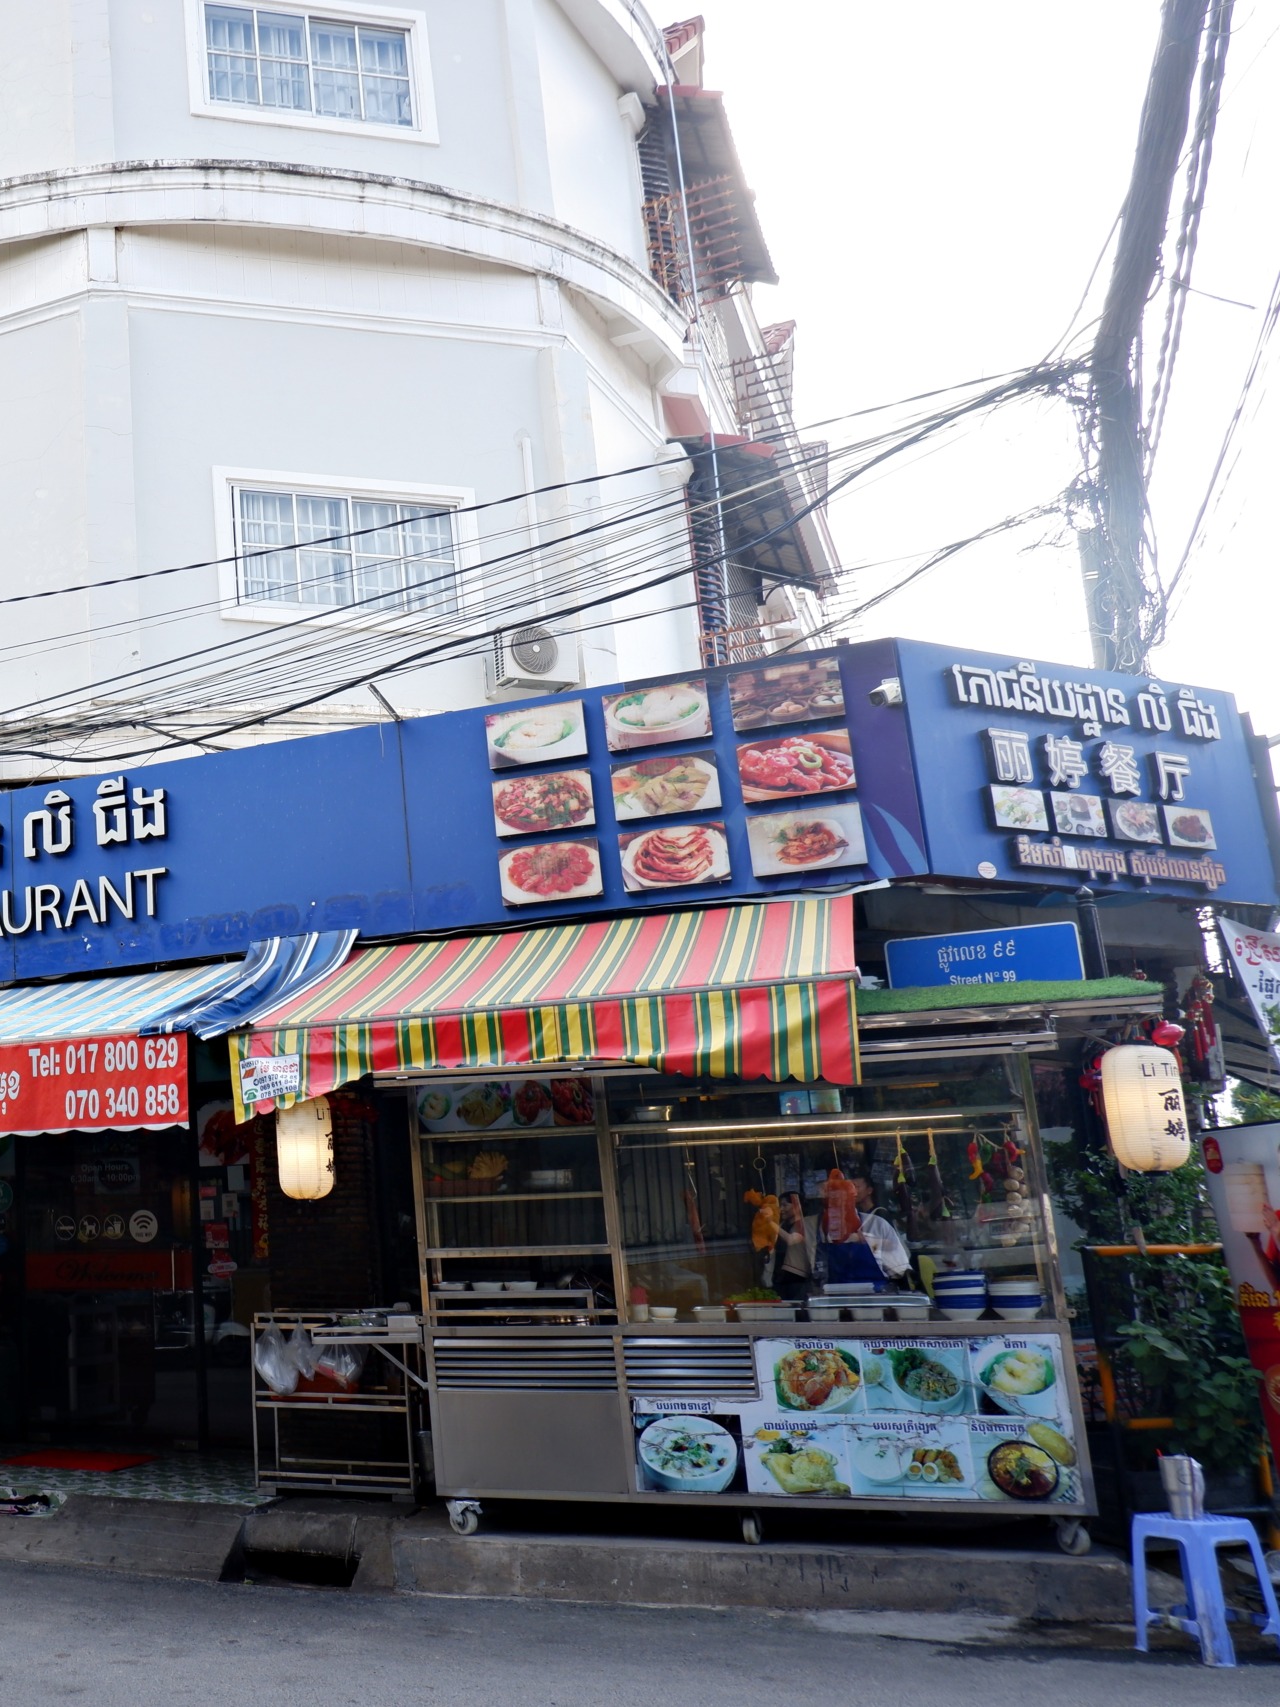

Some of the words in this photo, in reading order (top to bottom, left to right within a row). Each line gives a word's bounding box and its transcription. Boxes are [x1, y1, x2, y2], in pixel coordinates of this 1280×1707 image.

[952, 662, 1130, 737] ភោជនីយដ្ឋាន
[988, 728, 1191, 801] 丽婷餐厅
[993, 939, 1016, 957] ៩៩
[949, 973, 982, 986] Street
[1002, 970, 1016, 982] 99
[29, 1047, 60, 1077] Tel:
[65, 1044, 98, 1075] 017
[104, 1040, 138, 1072] 800
[144, 1038, 179, 1070] 629
[1141, 1063, 1156, 1077] Li
[65, 1088, 99, 1120] 070
[105, 1086, 139, 1118] 340
[145, 1084, 179, 1116] 858
